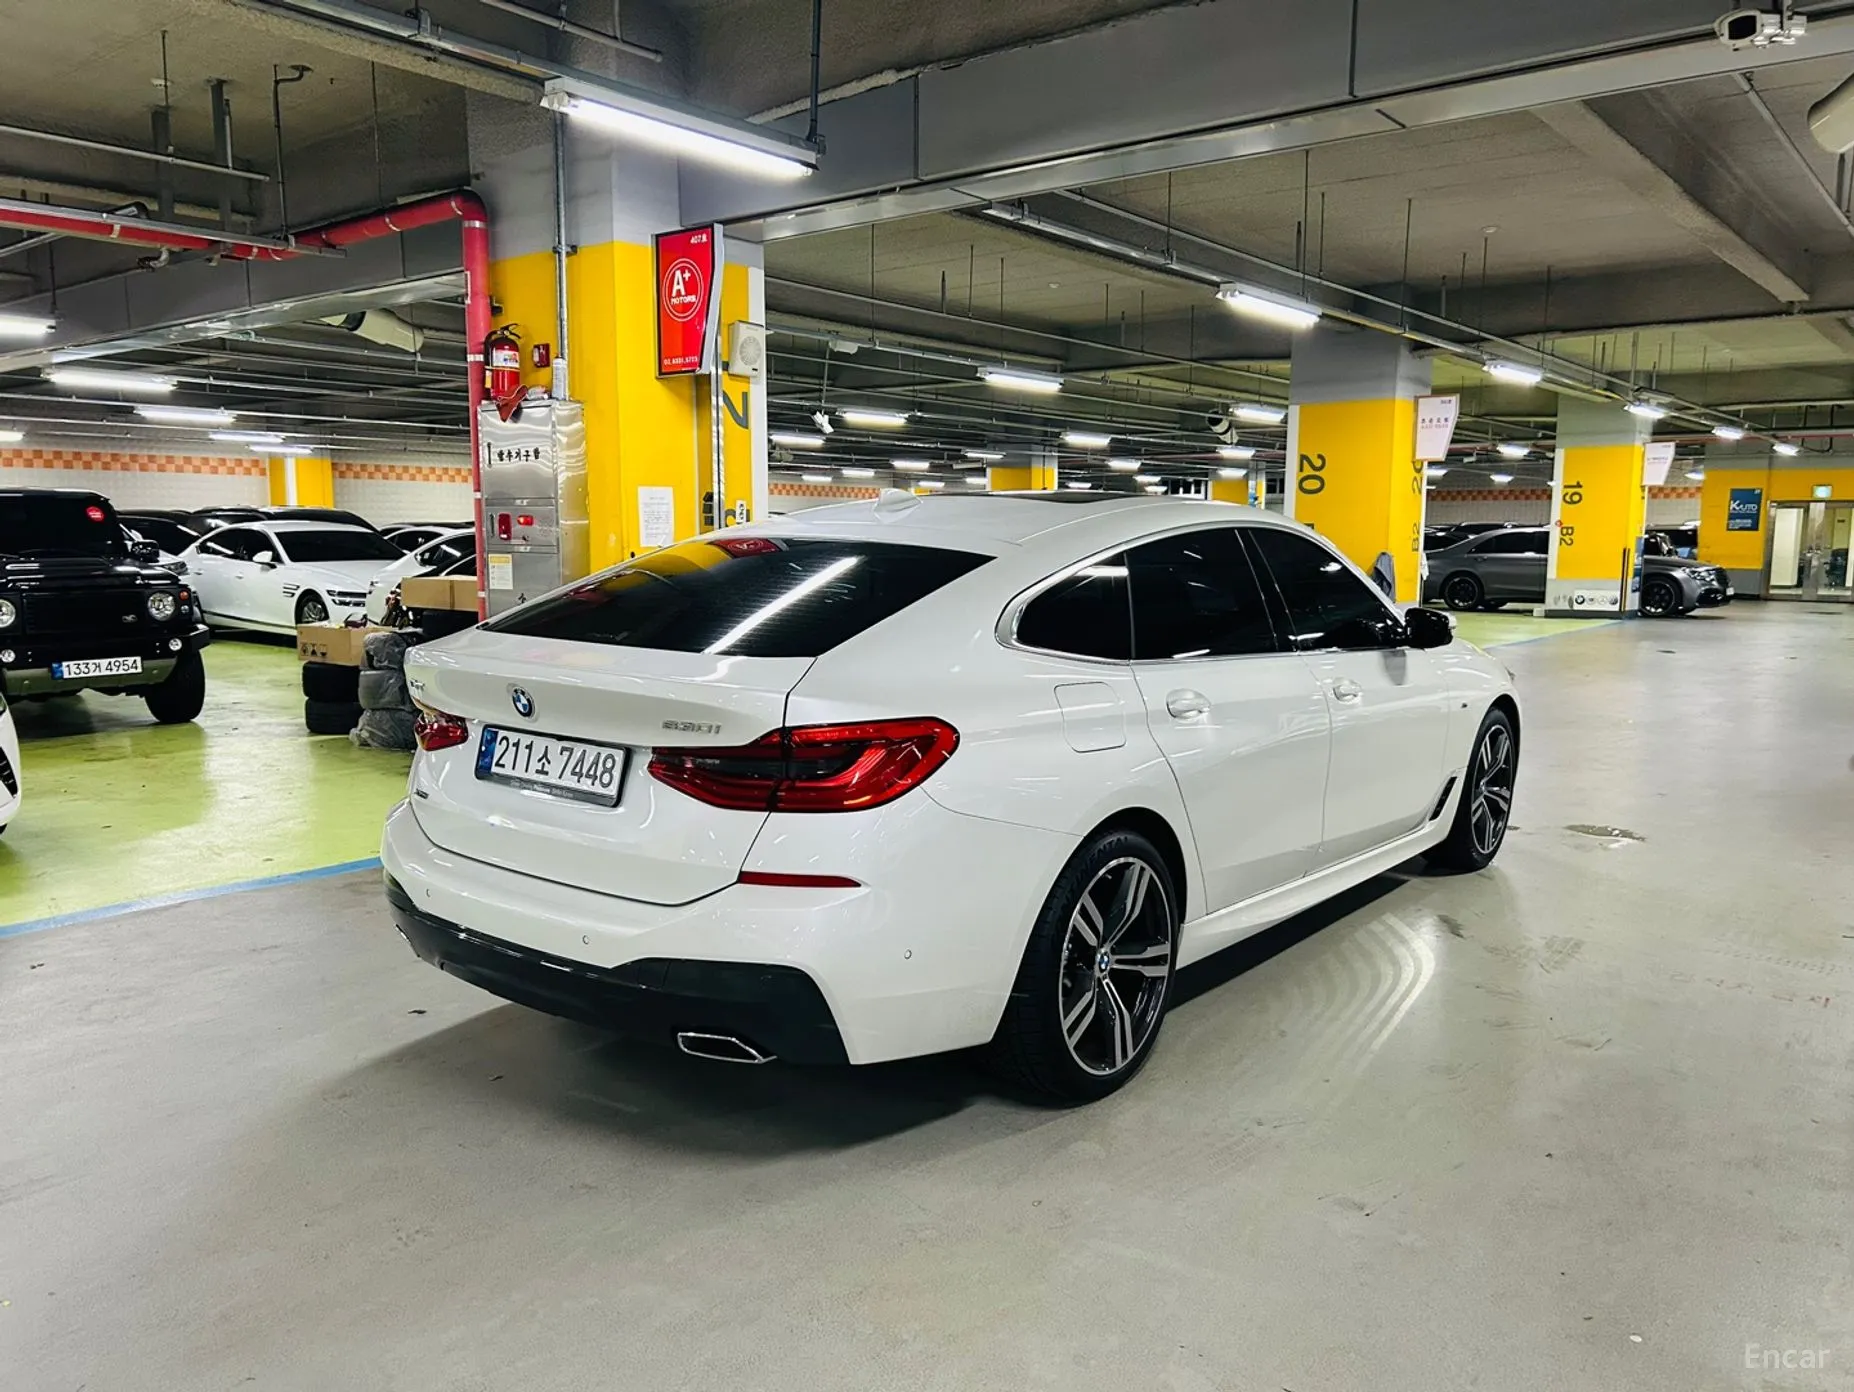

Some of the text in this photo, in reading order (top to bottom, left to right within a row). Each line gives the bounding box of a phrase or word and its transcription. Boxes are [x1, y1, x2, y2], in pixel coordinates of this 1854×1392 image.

[1298, 453, 1327, 495] 20
[1562, 480, 1583, 505] 19
[1559, 526, 1574, 546] B2
[105, 659, 138, 673] 4954
[494, 735, 617, 788] 211소 7448
